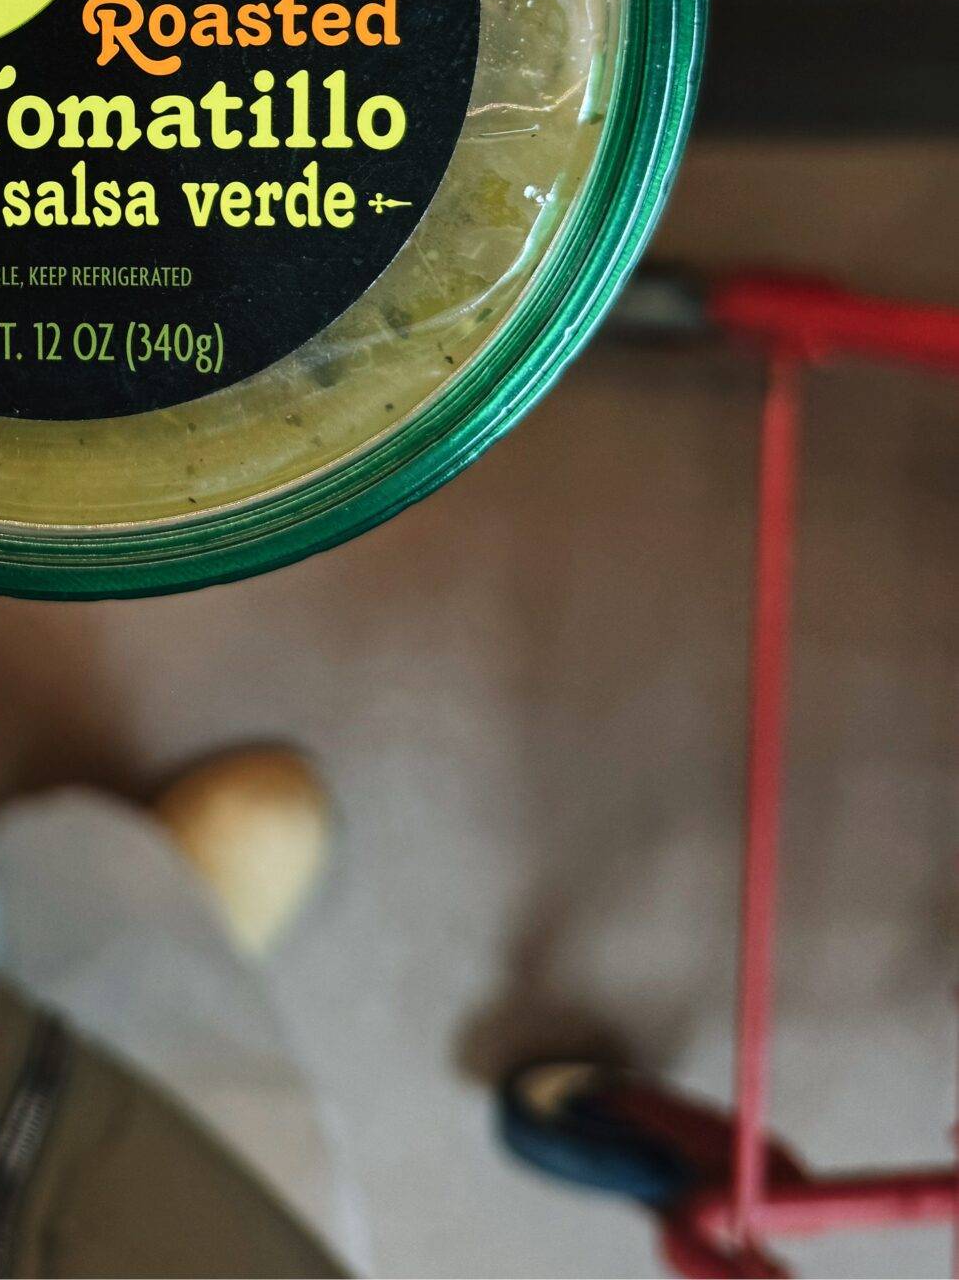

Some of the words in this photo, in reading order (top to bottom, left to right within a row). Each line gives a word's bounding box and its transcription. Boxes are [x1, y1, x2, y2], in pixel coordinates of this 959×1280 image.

[2, 160, 159, 228] salsa
[182, 160, 355, 228] verde
[29, 267, 67, 286] KEEP
[72, 267, 193, 287] REFRIGERATED
[33, 323, 62, 360] 12
[73, 323, 115, 361] OZ
[125, 322, 225, 373] (340g)
